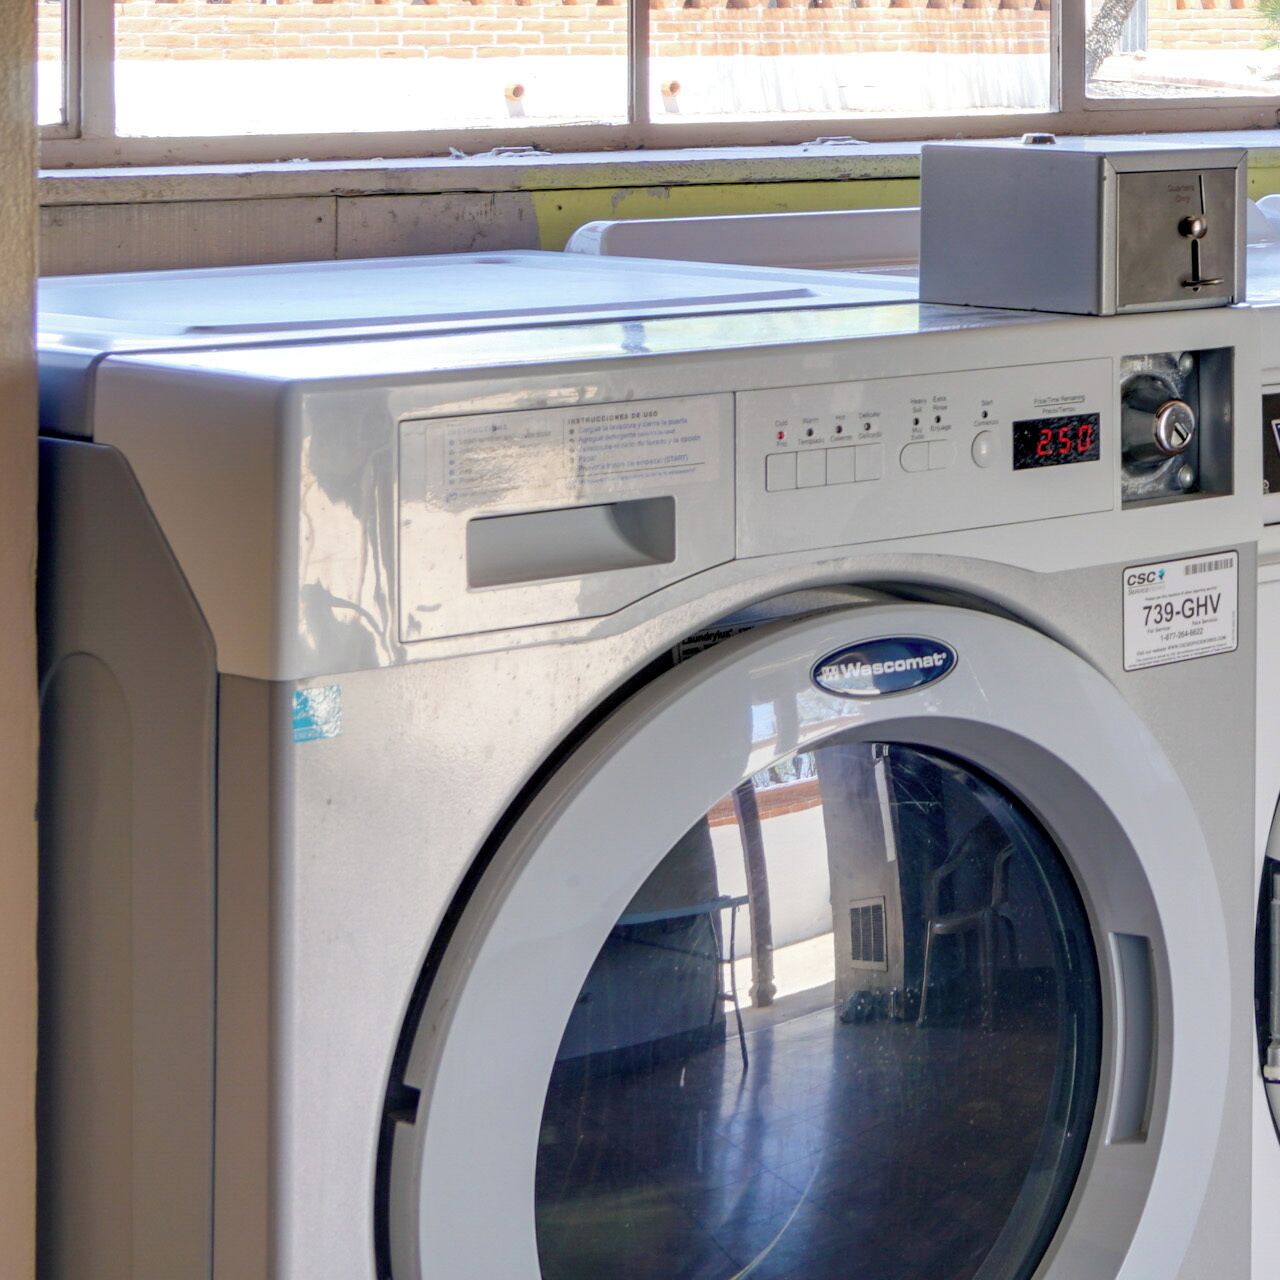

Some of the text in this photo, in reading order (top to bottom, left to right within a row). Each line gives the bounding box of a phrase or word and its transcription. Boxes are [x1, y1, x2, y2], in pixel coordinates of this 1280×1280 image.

[1127, 571, 1156, 586] CSC
[1142, 592, 1222, 626] 739-GHV
[840, 652, 944, 678] Wascomat
